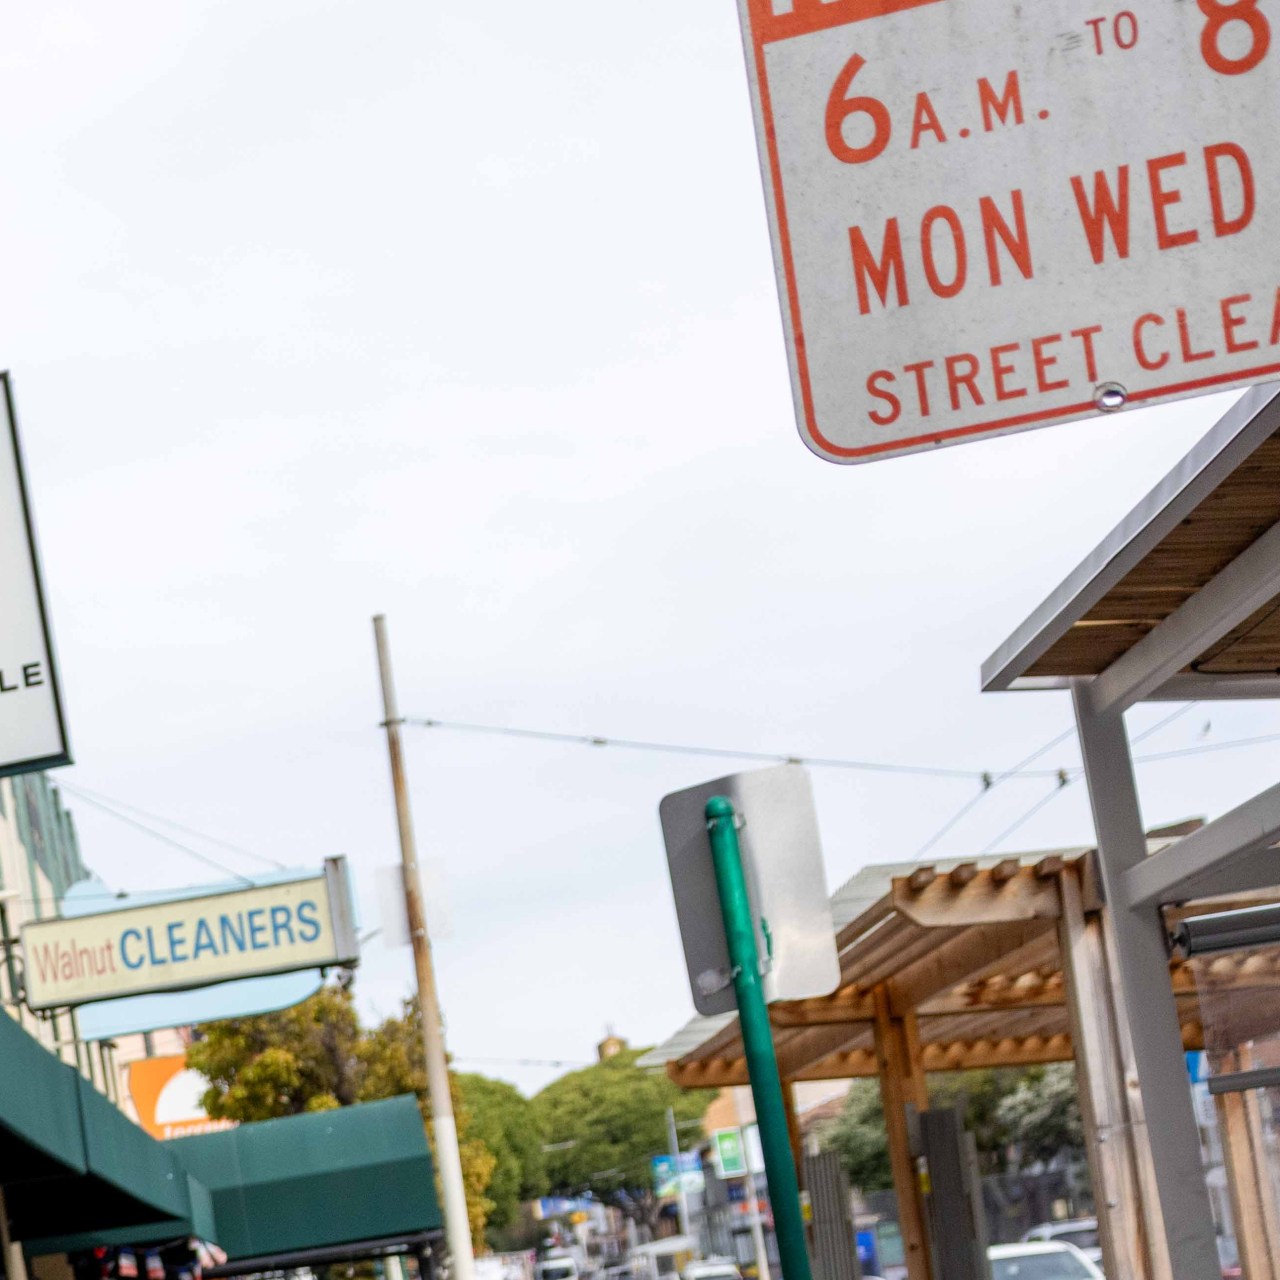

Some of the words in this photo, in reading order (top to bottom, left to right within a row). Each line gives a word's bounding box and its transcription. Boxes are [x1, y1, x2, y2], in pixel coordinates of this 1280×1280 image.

[823, 52, 893, 165] 6
[909, 70, 1052, 150] A.M.
[1085, 10, 1140, 56] TO
[1197, 0, 1272, 76] 8
[847, 189, 1034, 316] MON
[1070, 142, 1256, 265] WED
[865, 325, 1104, 427] STREET
[32, 936, 116, 985] Walnut
[120, 900, 322, 971] CLEANERS
